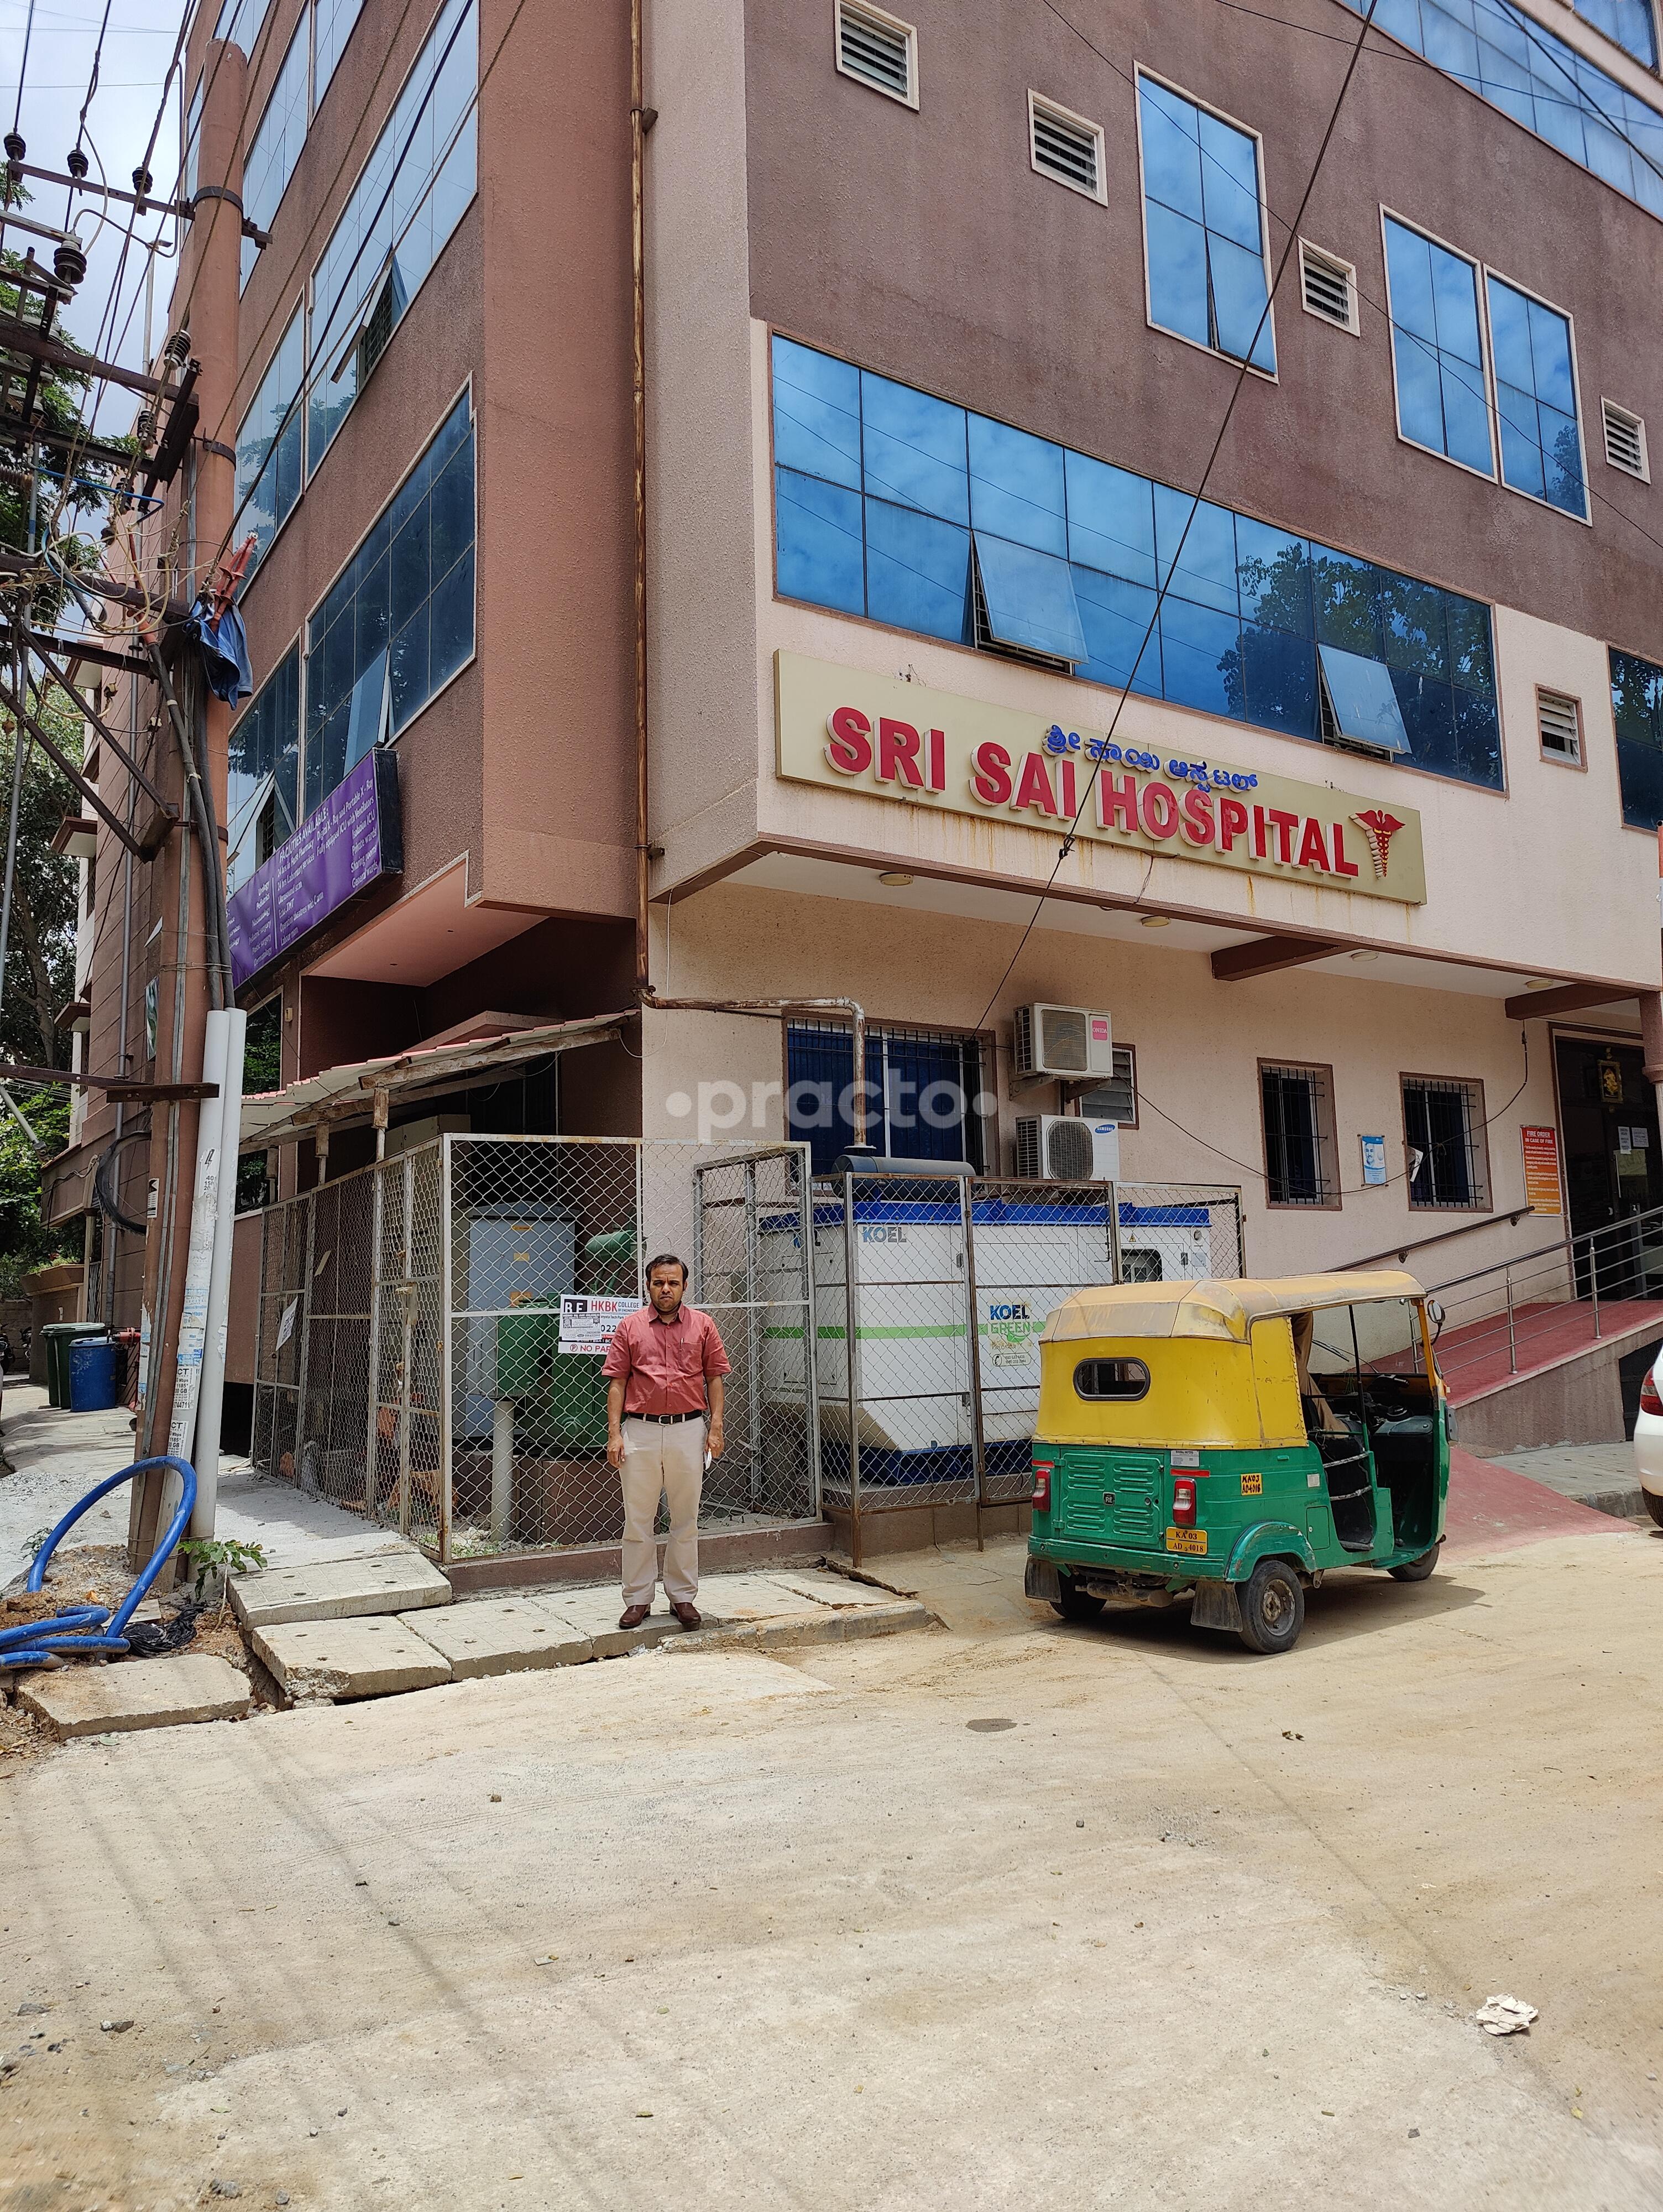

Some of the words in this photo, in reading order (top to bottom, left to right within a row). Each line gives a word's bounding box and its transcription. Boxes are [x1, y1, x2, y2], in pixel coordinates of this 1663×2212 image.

[825, 706, 945, 793] SRI
[969, 742, 1076, 821] SAI
[1096, 770, 1359, 879] HOSPITAL
[366, 810, 375, 826] ICU
[352, 838, 364, 857] Private
[364, 827, 377, 843] wards
[351, 854, 365, 874] Sharing
[365, 844, 377, 860] rooms
[352, 867, 367, 889] General
[365, 859, 378, 877] wards
[862, 1227, 907, 1243] KOEL
[591, 1300, 618, 1312] HKBK
[990, 1305, 1030, 1321] KOEL
[991, 1321, 1031, 1334] GREEN
[1175, 1531, 1187, 1540] KA
[1188, 1544, 1204, 1552] 4018
